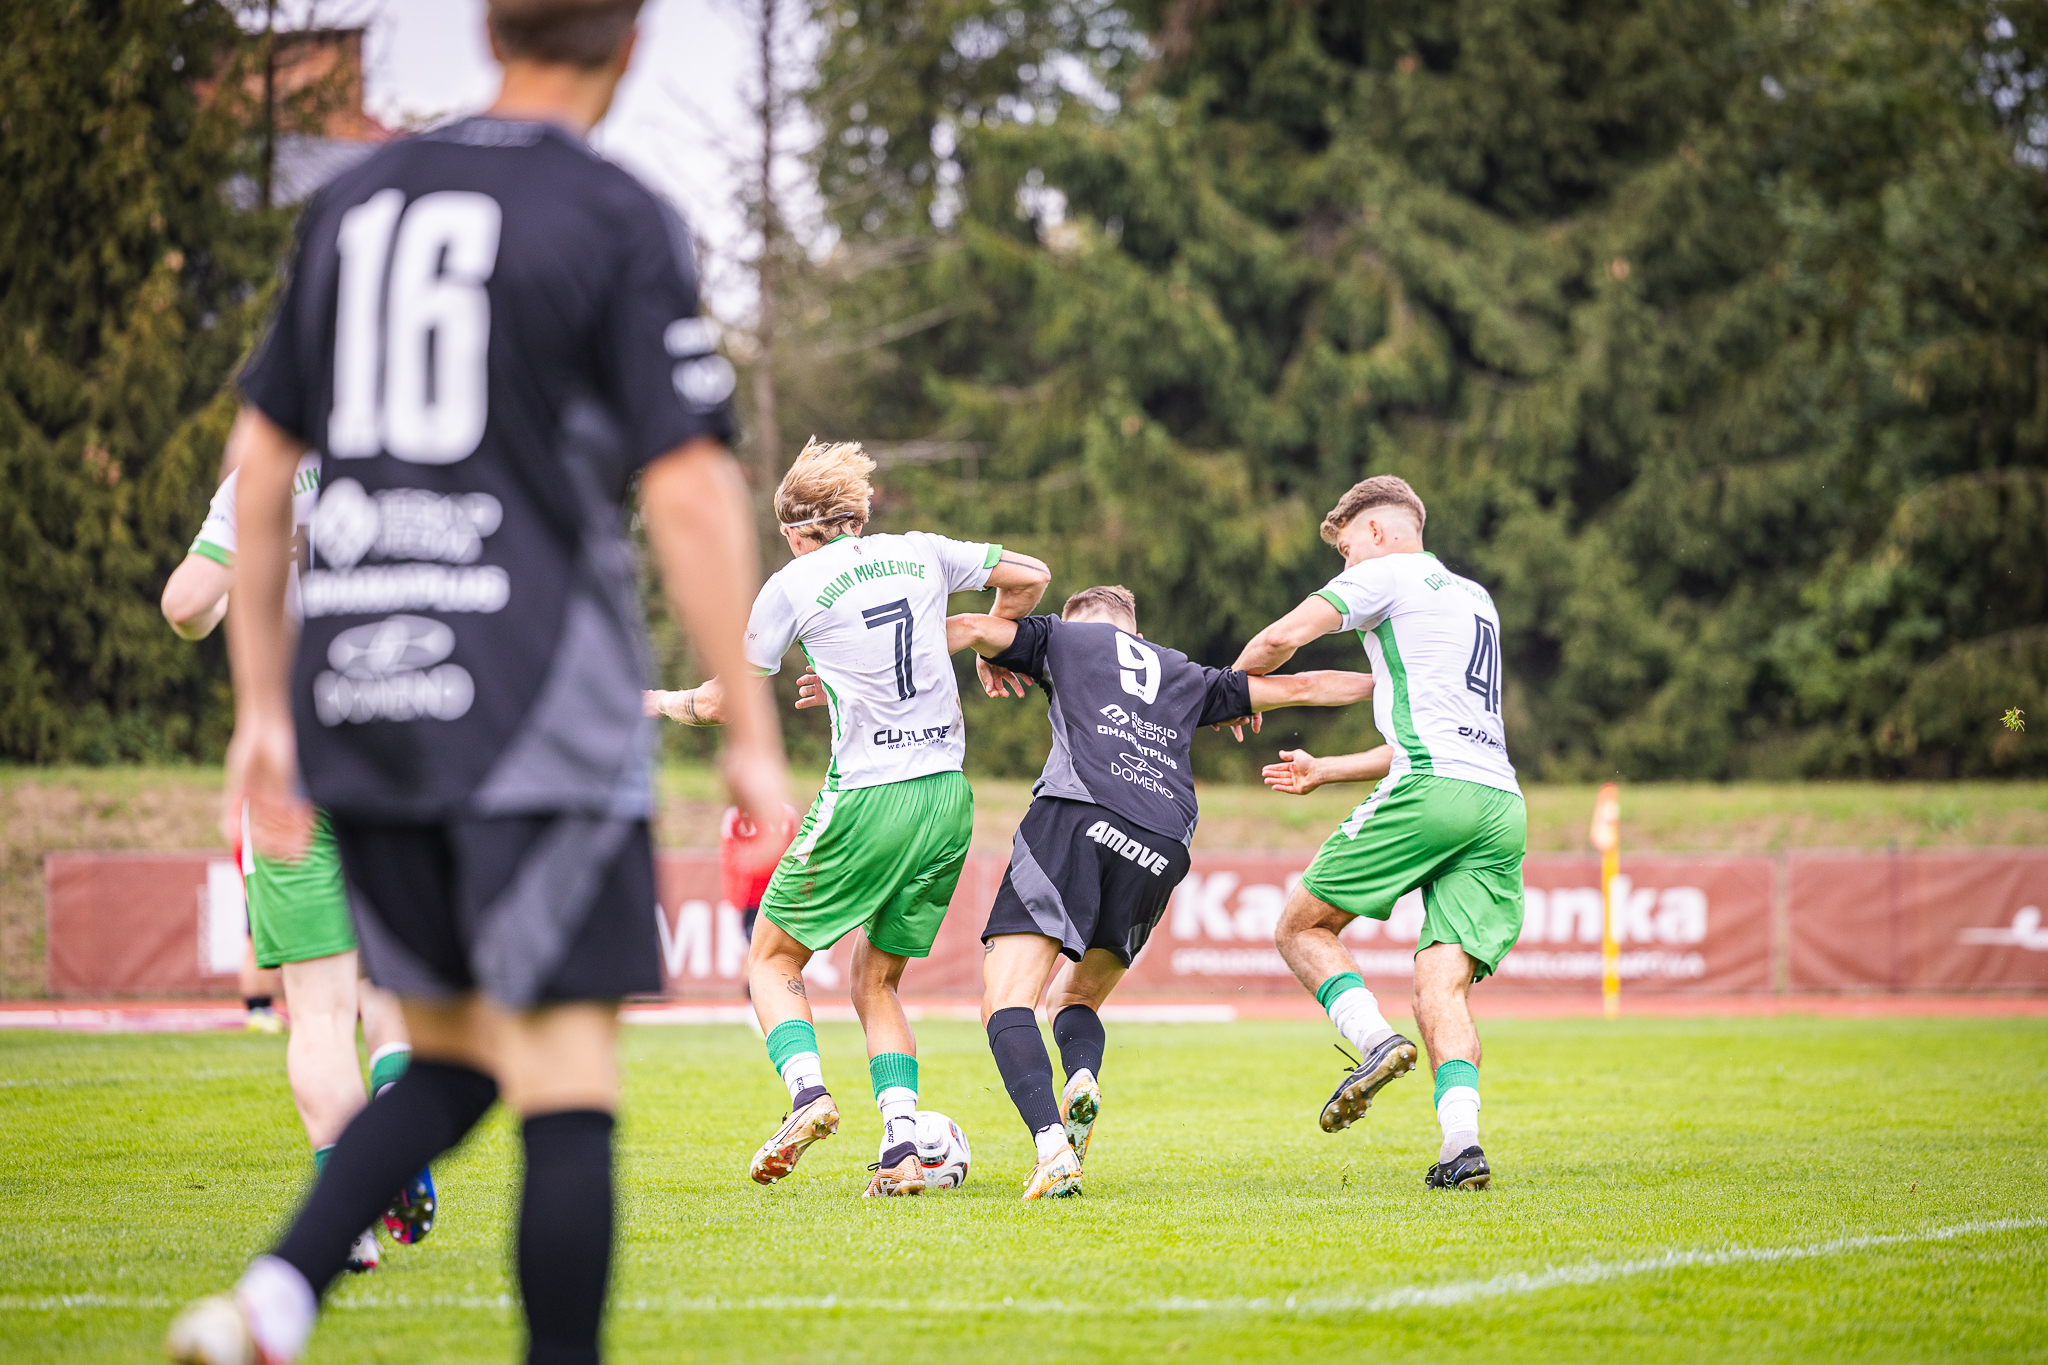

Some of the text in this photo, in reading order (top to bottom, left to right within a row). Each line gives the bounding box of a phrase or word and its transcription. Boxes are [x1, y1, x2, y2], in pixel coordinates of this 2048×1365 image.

[329, 188, 502, 465] 16
[292, 468, 321, 495] LIN
[816, 572, 855, 609] DALIN
[861, 598, 917, 702] 7
[1115, 631, 1162, 705] 9
[1465, 613, 1499, 715] 4
[1111, 761, 1174, 799] DOMENO
